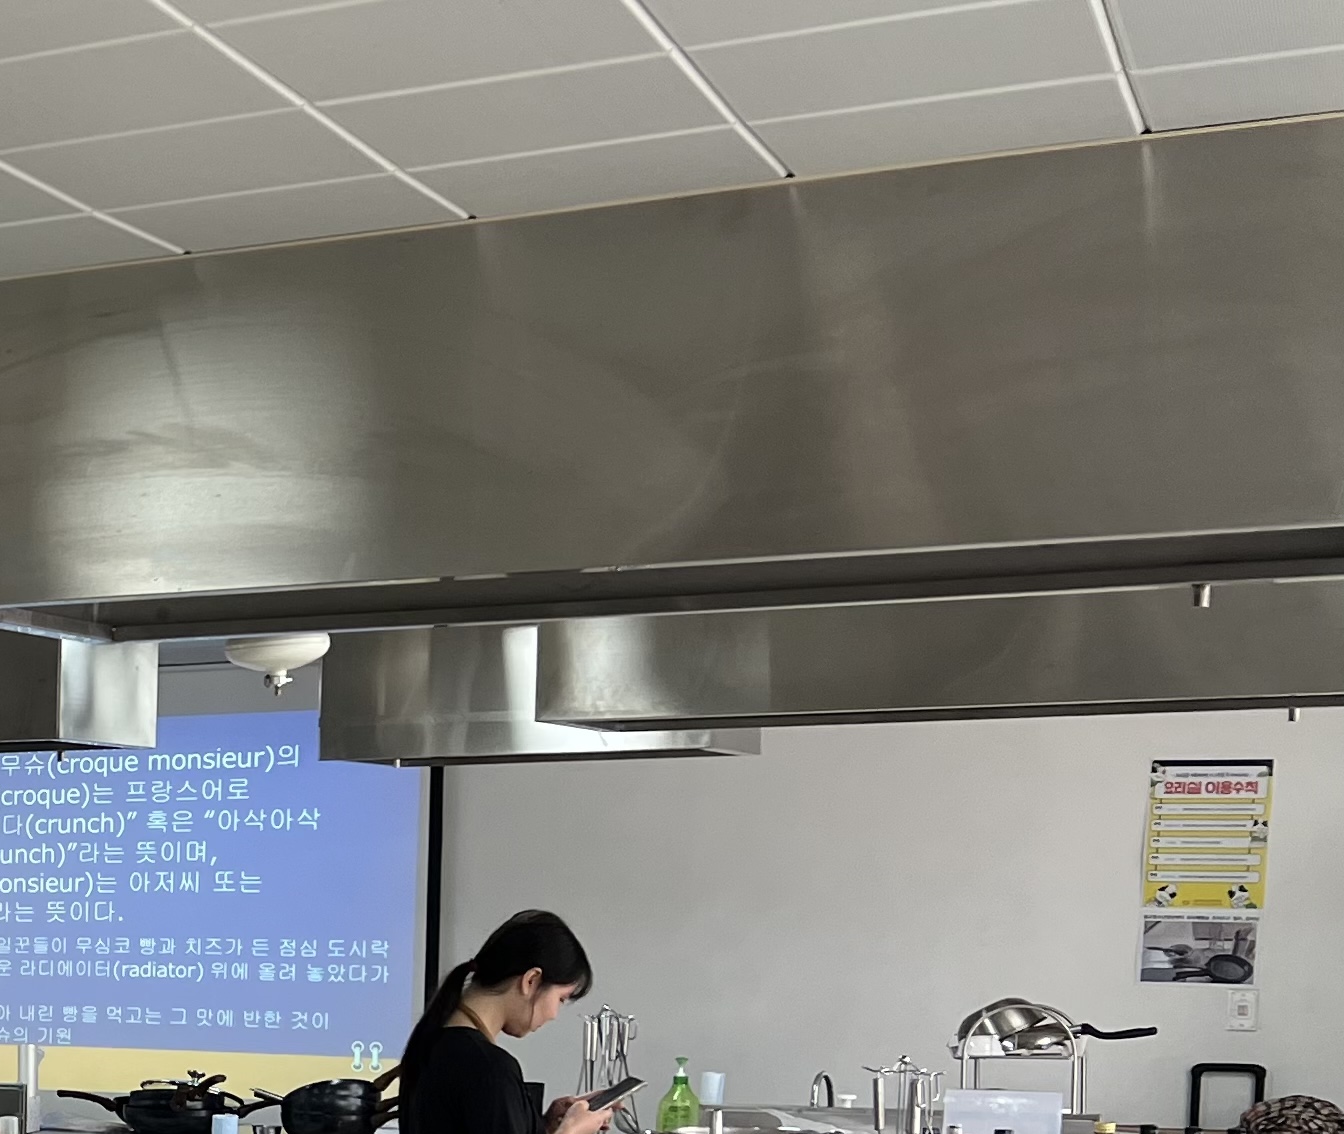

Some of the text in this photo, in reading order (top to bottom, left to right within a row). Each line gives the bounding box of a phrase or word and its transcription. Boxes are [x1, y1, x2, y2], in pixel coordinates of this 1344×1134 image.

[0, 752, 139, 780] 무슈(croque
[148, 744, 300, 773] monsieur)의
[125, 778, 250, 803] 프랑스어로
[1164, 780, 1202, 795] 요리실
[146, 810, 194, 833] 혹은
[135, 840, 217, 867] 뜻이며,
[129, 871, 200, 893] 아저씨
[213, 870, 262, 894] 또는
[46, 900, 124, 923] 뜻이다.
[75, 936, 130, 955] 무심코
[139, 937, 177, 956] 빵과
[185, 937, 243, 956] 치즈가
[251, 938, 270, 957] 든
[279, 938, 317, 958] 점심
[327, 939, 389, 959] 도시락
[20, 959, 204, 982] 라디에이터(radiator)
[210, 961, 249, 980] 위에
[258, 962, 296, 982] 올려
[306, 963, 390, 983] 놓았다가
[20, 1004, 54, 1022] 내린
[63, 1005, 97, 1023] 빵을
[106, 1006, 162, 1025] 먹고는
[169, 1007, 187, 1025] 그
[196, 1008, 234, 1027] 맛에
[244, 1009, 281, 1029] 반한
[291, 1011, 329, 1030] 것이
[37, 1027, 72, 1045] 기원
